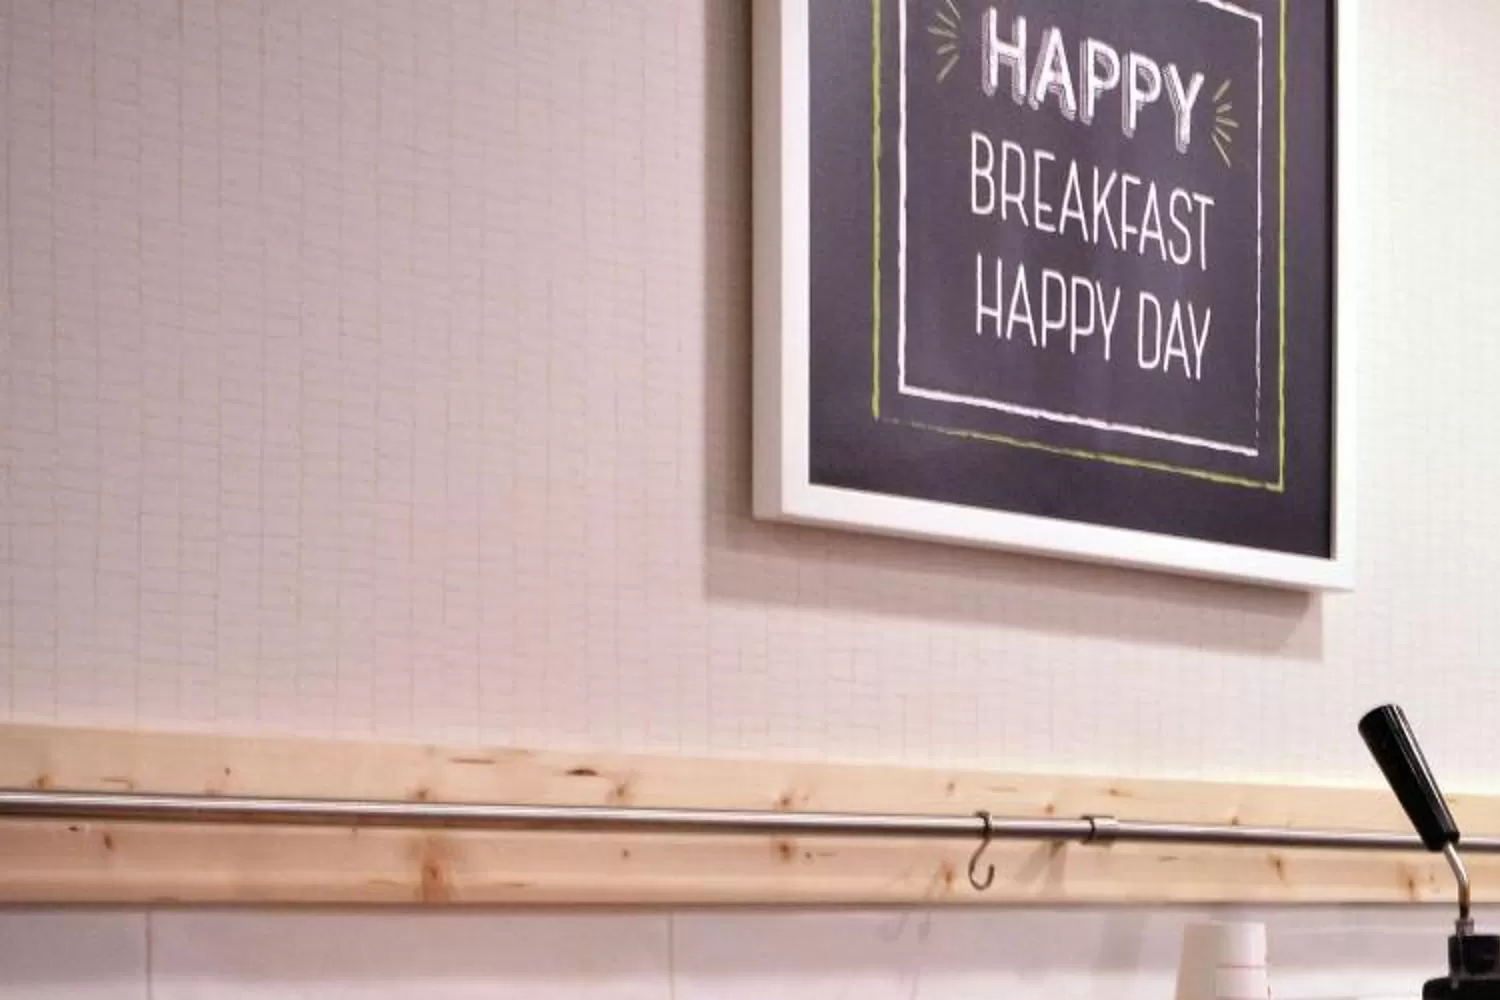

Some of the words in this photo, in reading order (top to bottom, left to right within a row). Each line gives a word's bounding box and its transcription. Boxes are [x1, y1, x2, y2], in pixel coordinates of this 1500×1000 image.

[981, 4, 1204, 154] HAPPY
[971, 131, 1214, 271] BREAKFAST
[975, 252, 1121, 361] HAPPY
[1137, 291, 1212, 380] DAY
